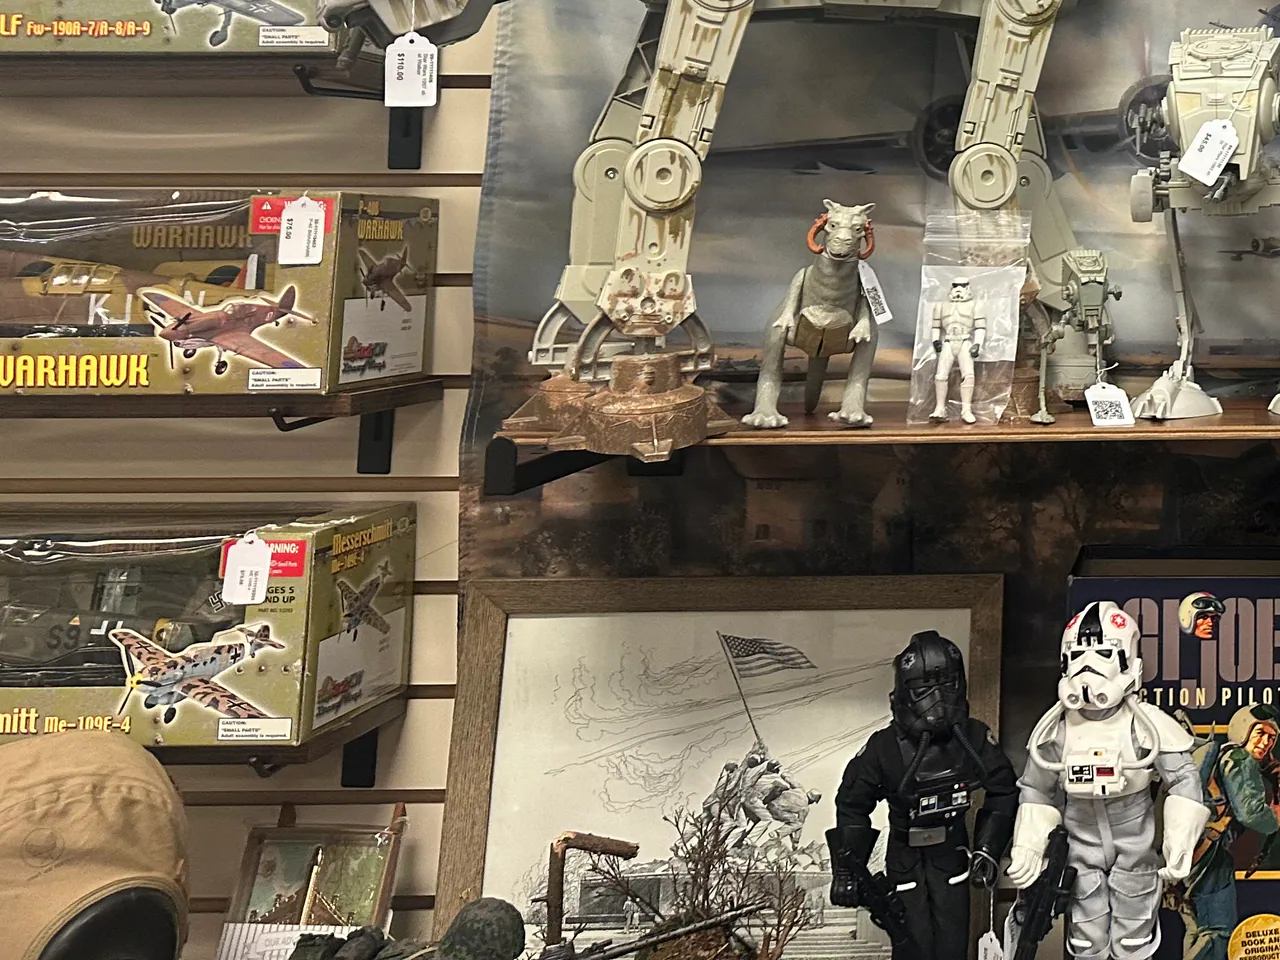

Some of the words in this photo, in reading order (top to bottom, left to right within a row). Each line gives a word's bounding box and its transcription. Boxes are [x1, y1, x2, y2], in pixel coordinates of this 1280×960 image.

[26, 19, 151, 38] Fw-190A-7/A-8/A-9
[396, 52, 405, 81] $110.00
[1197, 132, 1212, 153] $45.00
[131, 225, 254, 249] WARHAWK
[357, 219, 404, 240] WARHAWK
[0, 354, 149, 388] WARHAWK
[332, 517, 394, 555] Messerschmitt
[265, 596, 280, 604] ND
[282, 596, 296, 604] UP
[267, 586, 286, 594] GES
[288, 586, 295, 594] 5
[1241, 938, 1266, 948] BOOK
[1245, 928, 1280, 939] DELUXE
